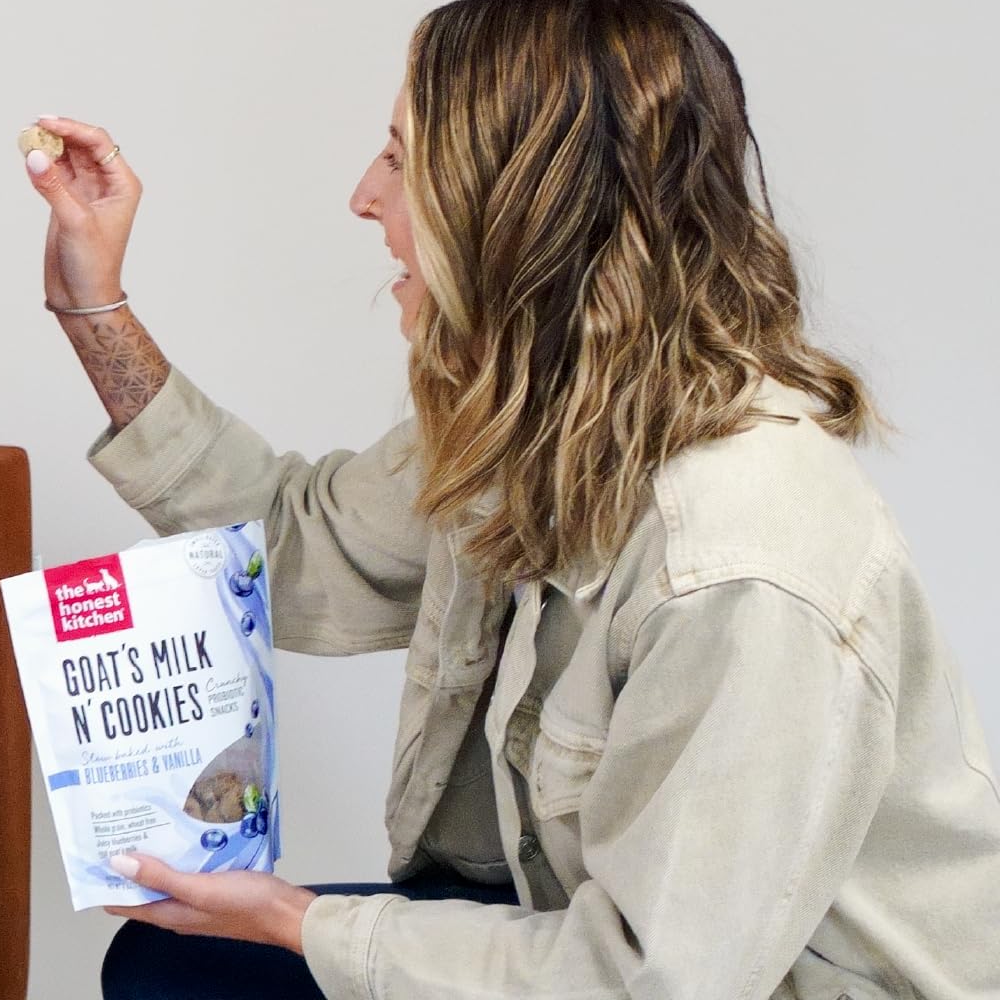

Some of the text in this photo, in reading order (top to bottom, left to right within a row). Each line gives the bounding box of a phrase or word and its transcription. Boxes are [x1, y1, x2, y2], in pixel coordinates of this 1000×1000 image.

[55, 583, 84, 601] the
[58, 591, 121, 616] honest
[61, 608, 124, 632] kitchen
[62, 630, 213, 697] GOAT'S MILK
[101, 683, 204, 740] COOKIES
[210, 702, 239, 717] SNACKS
[84, 748, 203, 785] BLUEBERRIES & VANILLA
